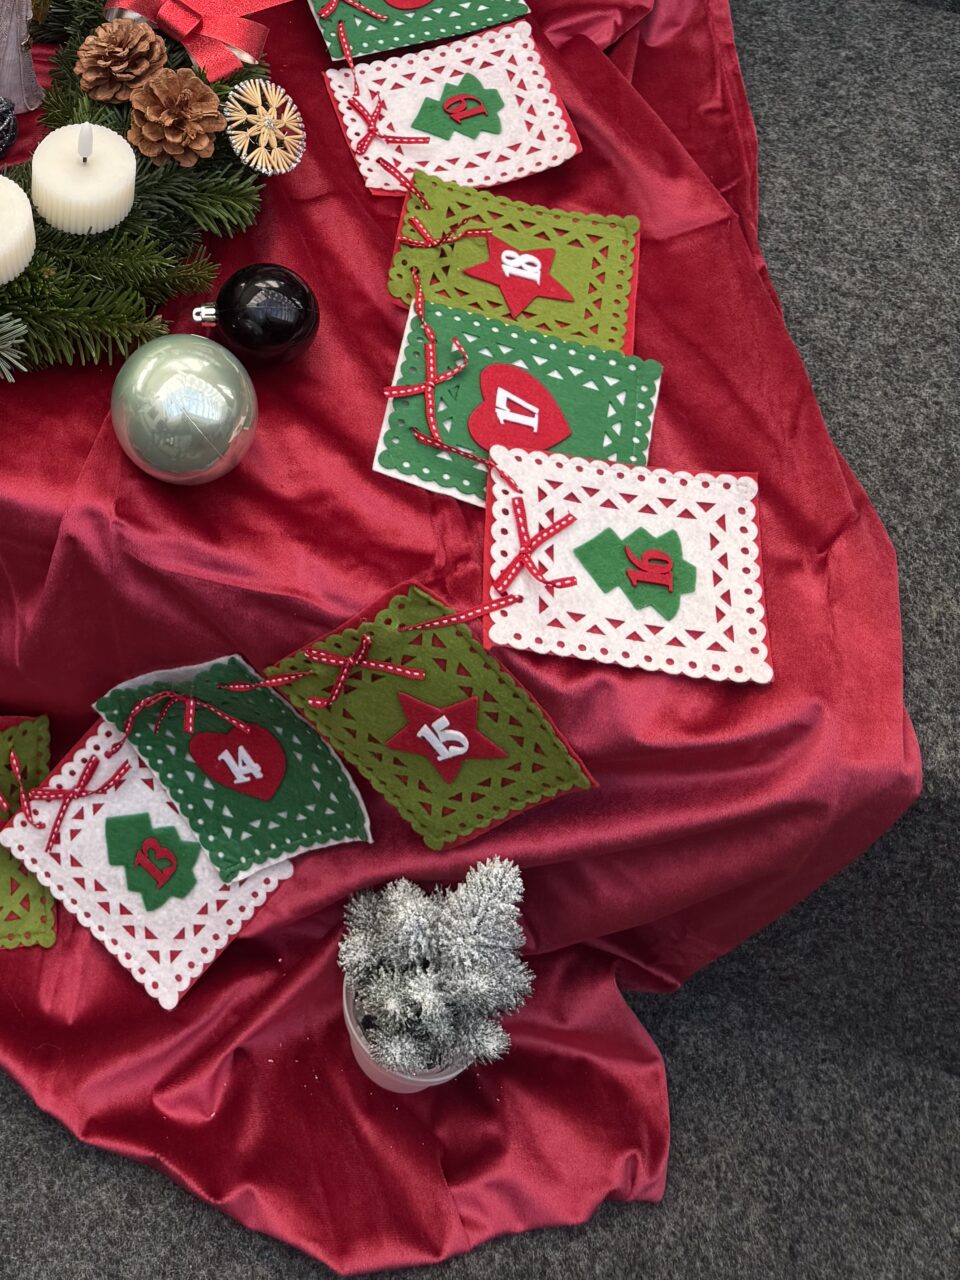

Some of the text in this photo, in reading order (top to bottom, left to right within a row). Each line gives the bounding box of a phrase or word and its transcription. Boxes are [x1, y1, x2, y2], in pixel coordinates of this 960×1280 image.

[442, 93, 488, 125] 19
[500, 249, 542, 285] 18
[494, 386, 540, 433] 17
[624, 545, 674, 593] 16
[416, 714, 470, 762] 15
[217, 745, 264, 785] 14
[133, 837, 177, 890] 13
